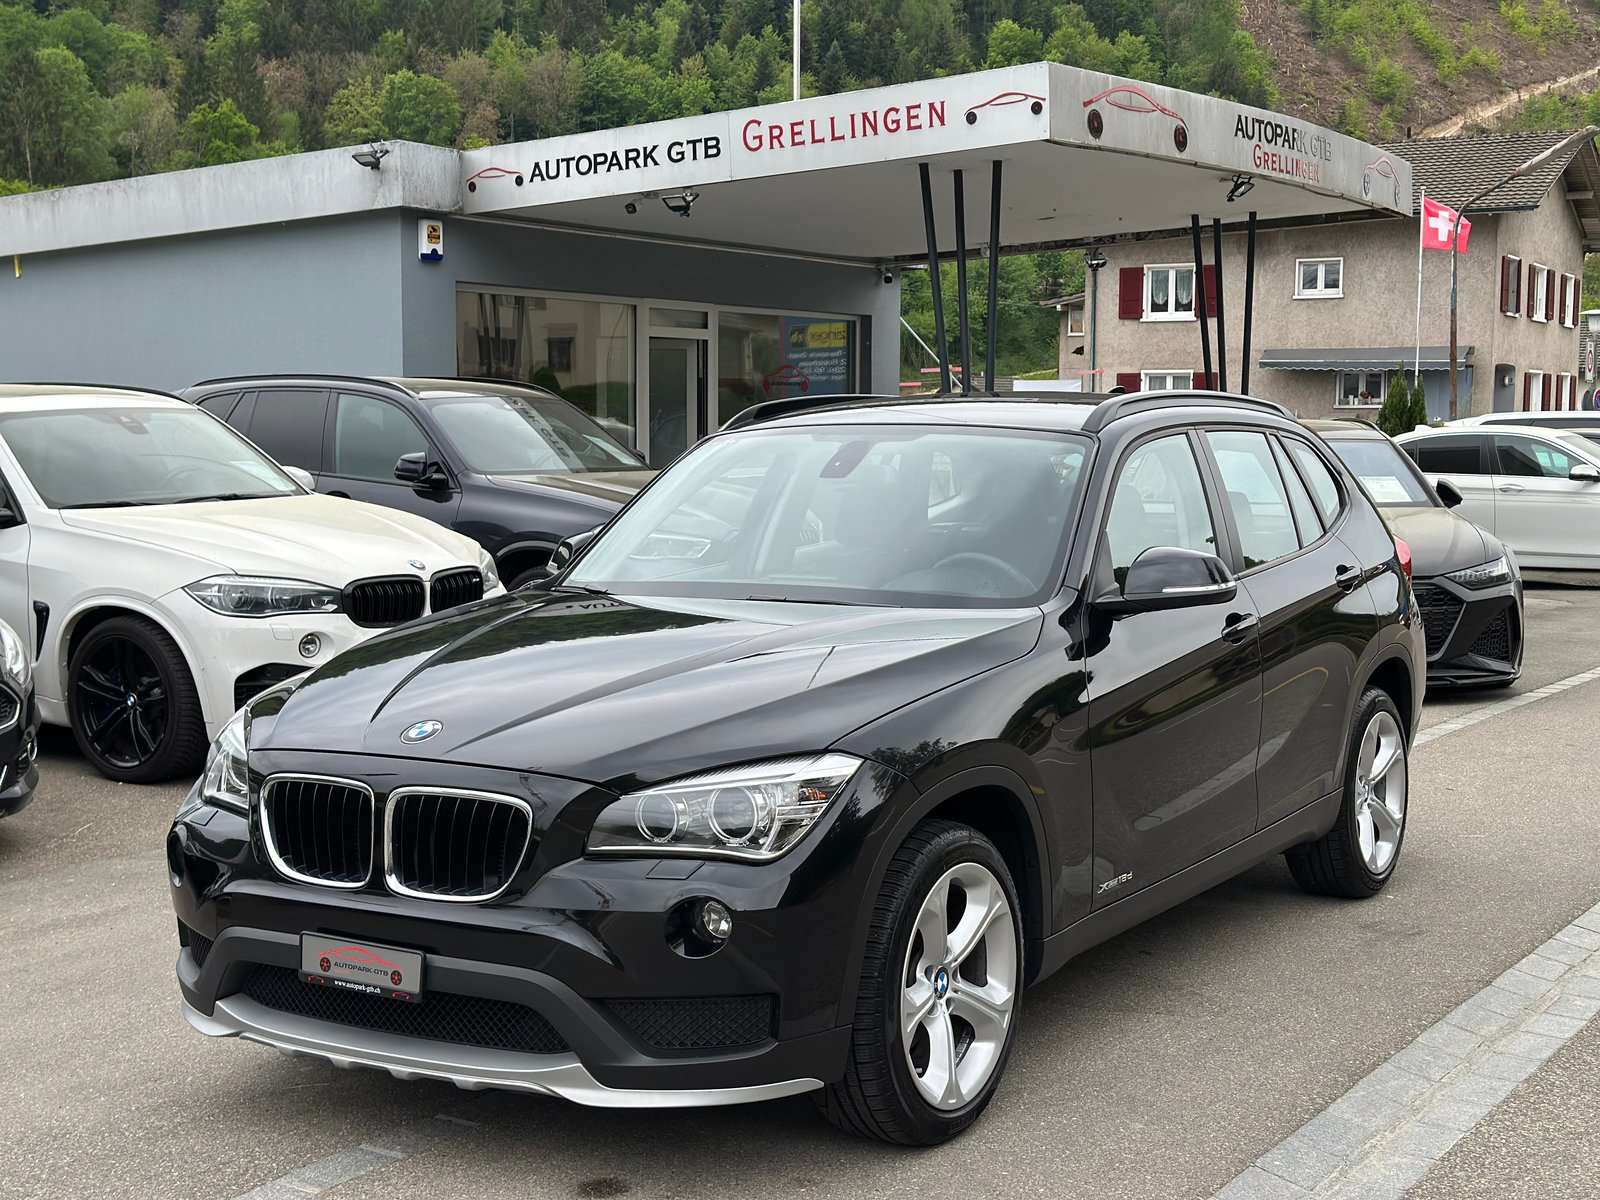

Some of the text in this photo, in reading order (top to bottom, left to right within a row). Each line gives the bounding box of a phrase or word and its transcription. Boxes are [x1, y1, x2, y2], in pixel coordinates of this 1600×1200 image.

[742, 100, 947, 152] GRELLINGEN
[1234, 114, 1332, 162] AUTOPARK GTB
[528, 135, 722, 183] AUTOPARK GTB
[1253, 143, 1320, 183] GRELLINGEN
[333, 961, 389, 977] AUTOPARK-GTB
